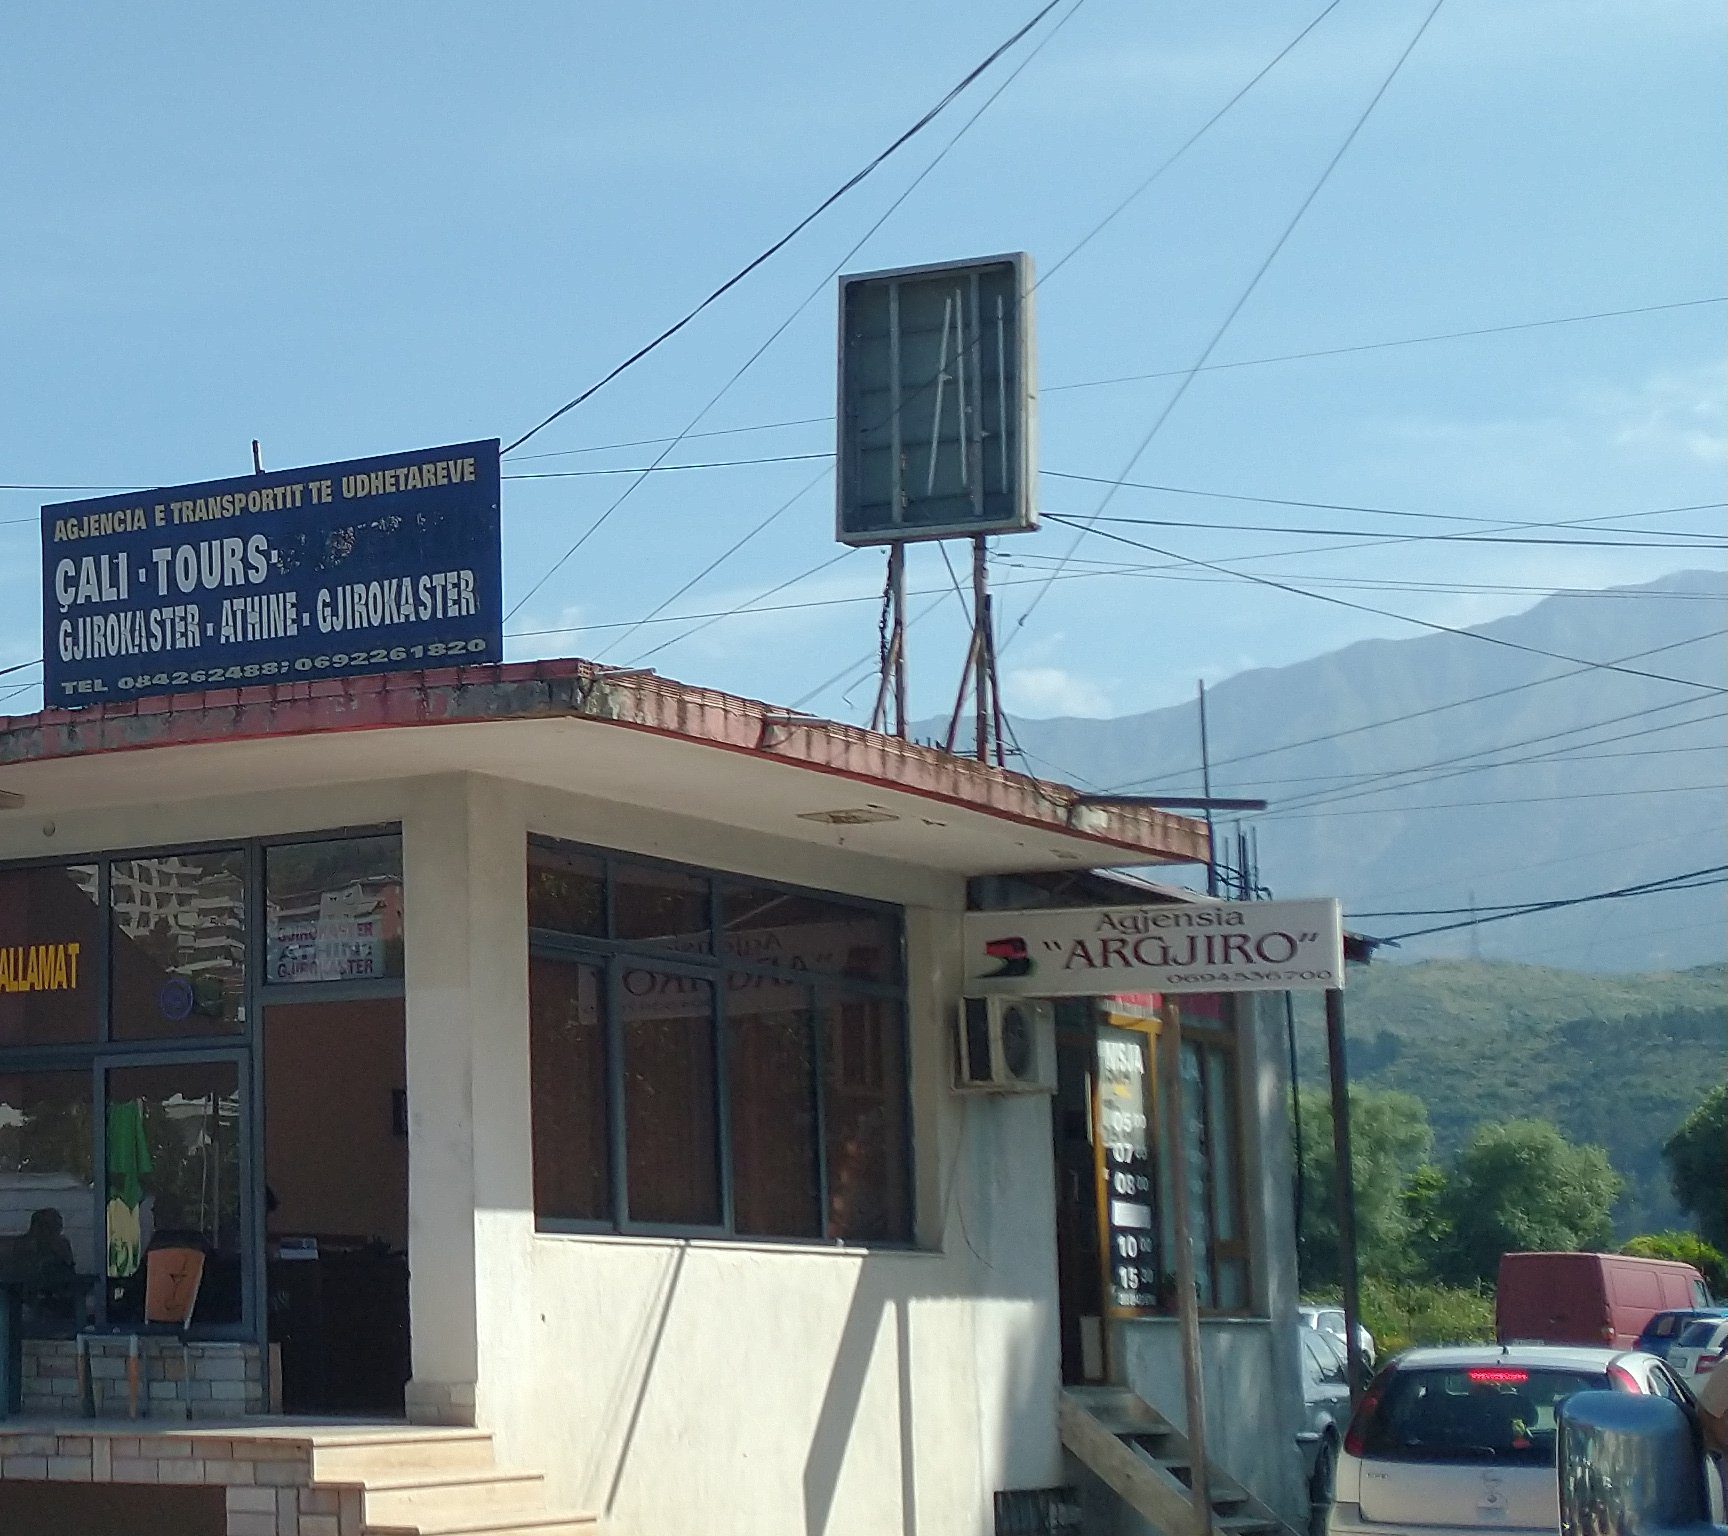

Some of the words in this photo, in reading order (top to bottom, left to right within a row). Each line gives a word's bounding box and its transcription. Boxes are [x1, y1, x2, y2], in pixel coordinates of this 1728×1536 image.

[54, 508, 147, 542] AGJENCIA
[155, 505, 165, 526] E
[171, 484, 303, 525] TRANSPORTIT
[309, 480, 332, 504] TE
[342, 457, 475, 499] UDHETAREVE
[55, 552, 128, 613] ÇALI
[152, 534, 268, 595] TOURS
[59, 604, 201, 662] GJIROKASTER
[220, 591, 297, 644] ATHINE
[317, 570, 476, 633] GJIROKASTER
[62, 679, 108, 694] TEL
[294, 638, 486, 671] 0692261820
[1096, 907, 1245, 935] Agjensia
